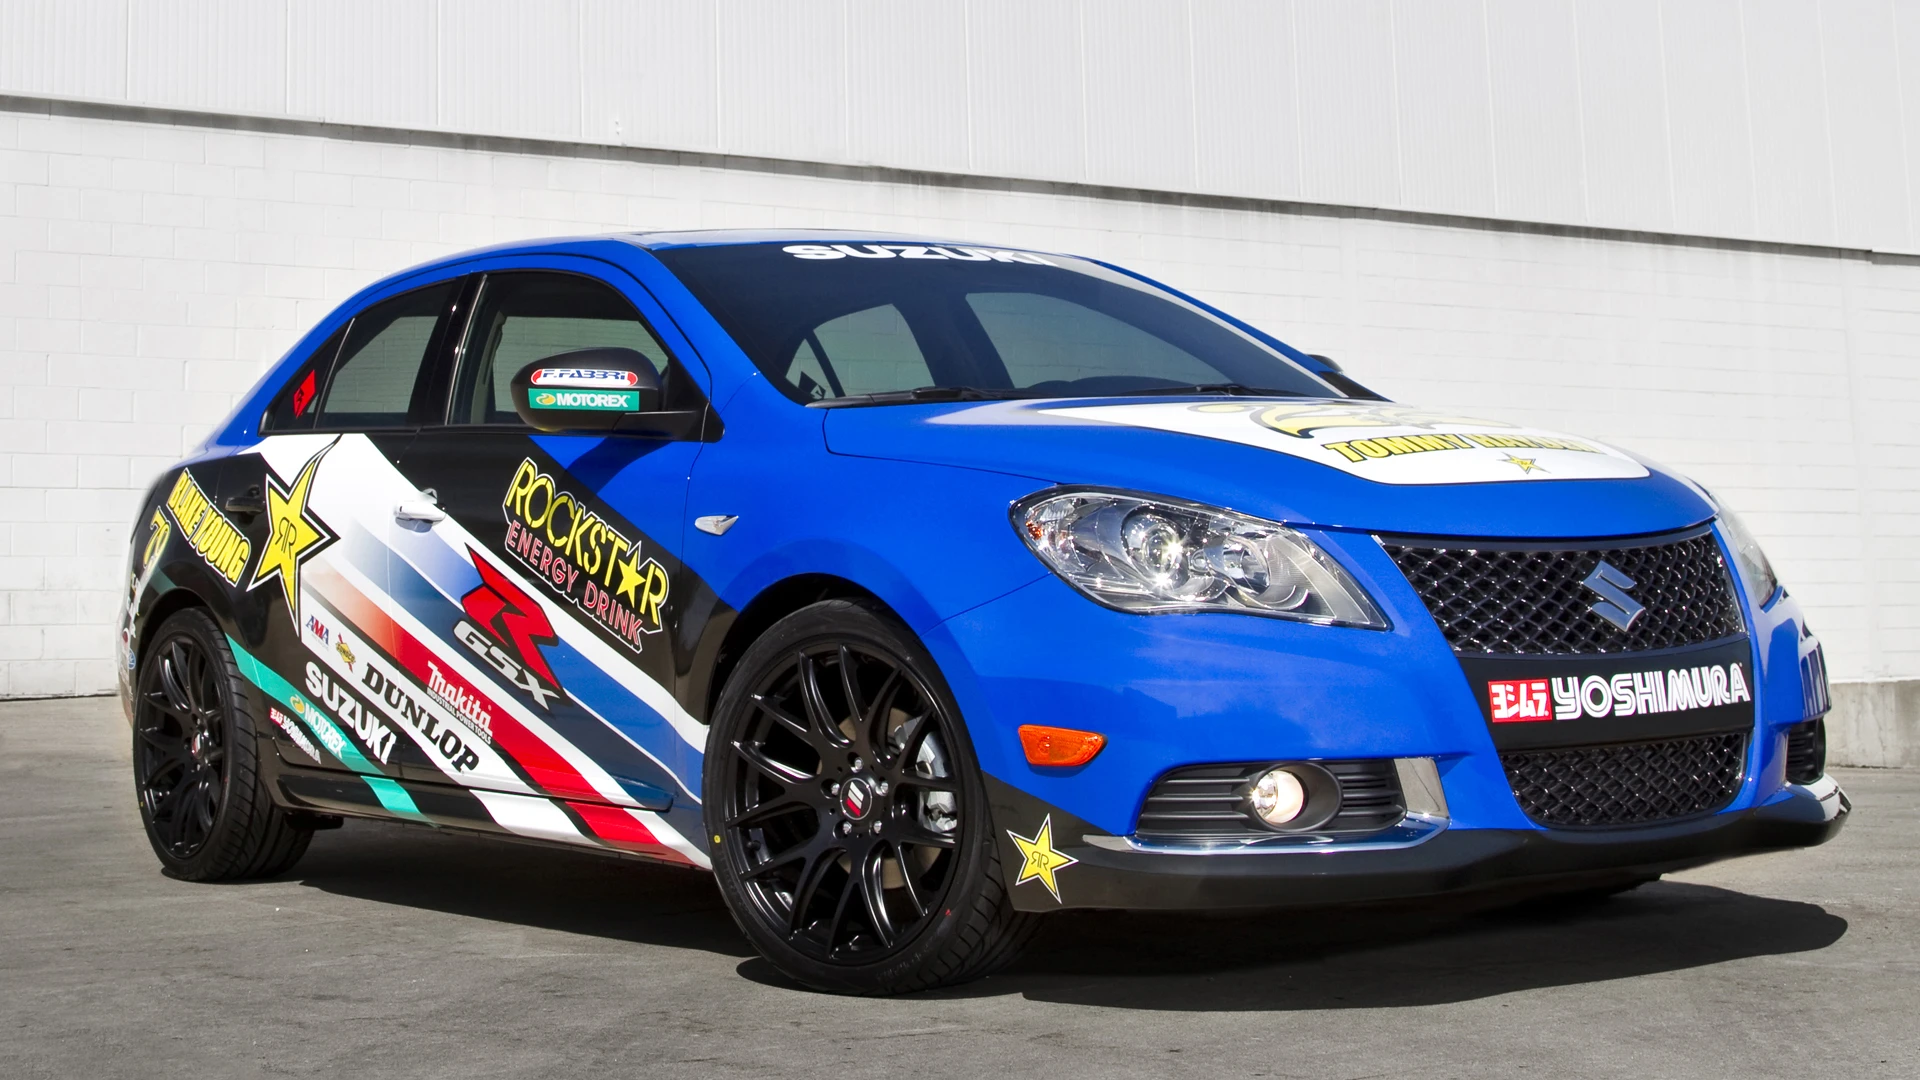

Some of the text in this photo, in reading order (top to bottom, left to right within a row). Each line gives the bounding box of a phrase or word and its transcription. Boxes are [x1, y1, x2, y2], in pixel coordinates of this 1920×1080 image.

[782, 243, 1059, 267] SUZUKI
[557, 393, 629, 408] MOTOREX
[1322, 433, 1475, 463] TOMMY
[166, 467, 251, 587] BLAKE YOUNG
[507, 520, 642, 645] ENERGY DRINK
[305, 614, 330, 646] AMA
[452, 619, 561, 711] GSX
[1552, 662, 1751, 720] YOSHIMURA
[304, 702, 347, 759] MOTOREX
[305, 661, 397, 765] SUZUKI
[361, 662, 480, 774] DUNLOP
[456, 710, 475, 731] POWER
[474, 724, 492, 745] TOOLS
